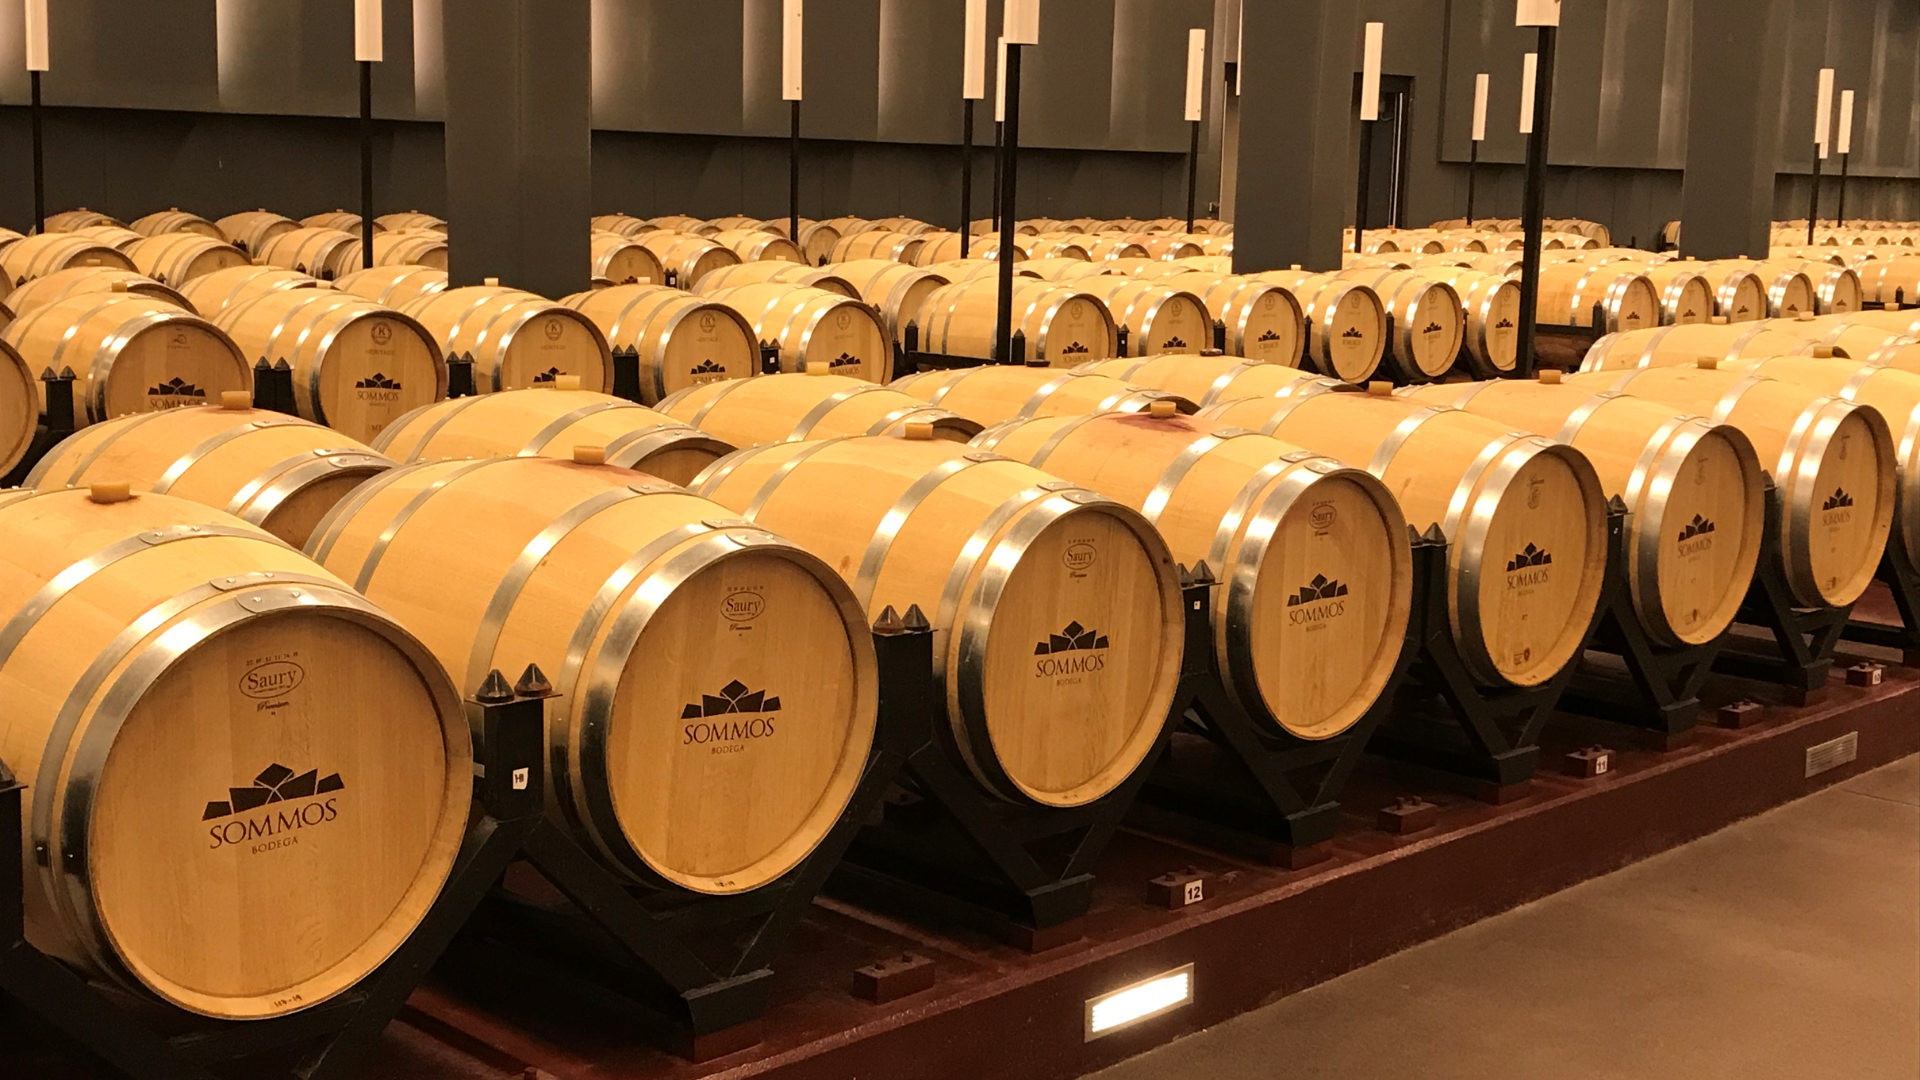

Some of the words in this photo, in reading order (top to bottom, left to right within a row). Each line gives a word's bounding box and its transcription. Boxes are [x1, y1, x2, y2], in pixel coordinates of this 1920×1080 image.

[356, 391, 398, 402] SOMMOS
[1067, 550, 1094, 563] Saury
[1507, 569, 1549, 590] SOMMOS
[725, 598, 761, 614] Saury
[1289, 600, 1345, 626] SOMMOS
[1035, 654, 1105, 678] SOMMOS
[247, 669, 297, 690] Saury
[1056, 677, 1082, 686] BODEGA
[683, 717, 776, 745] SOMMOS
[711, 744, 745, 755] BODEGA
[1597, 761, 1606, 771] 11
[209, 798, 337, 850] SOMMOS
[251, 836, 298, 855] BODEGA
[1187, 886, 1201, 900] 12
